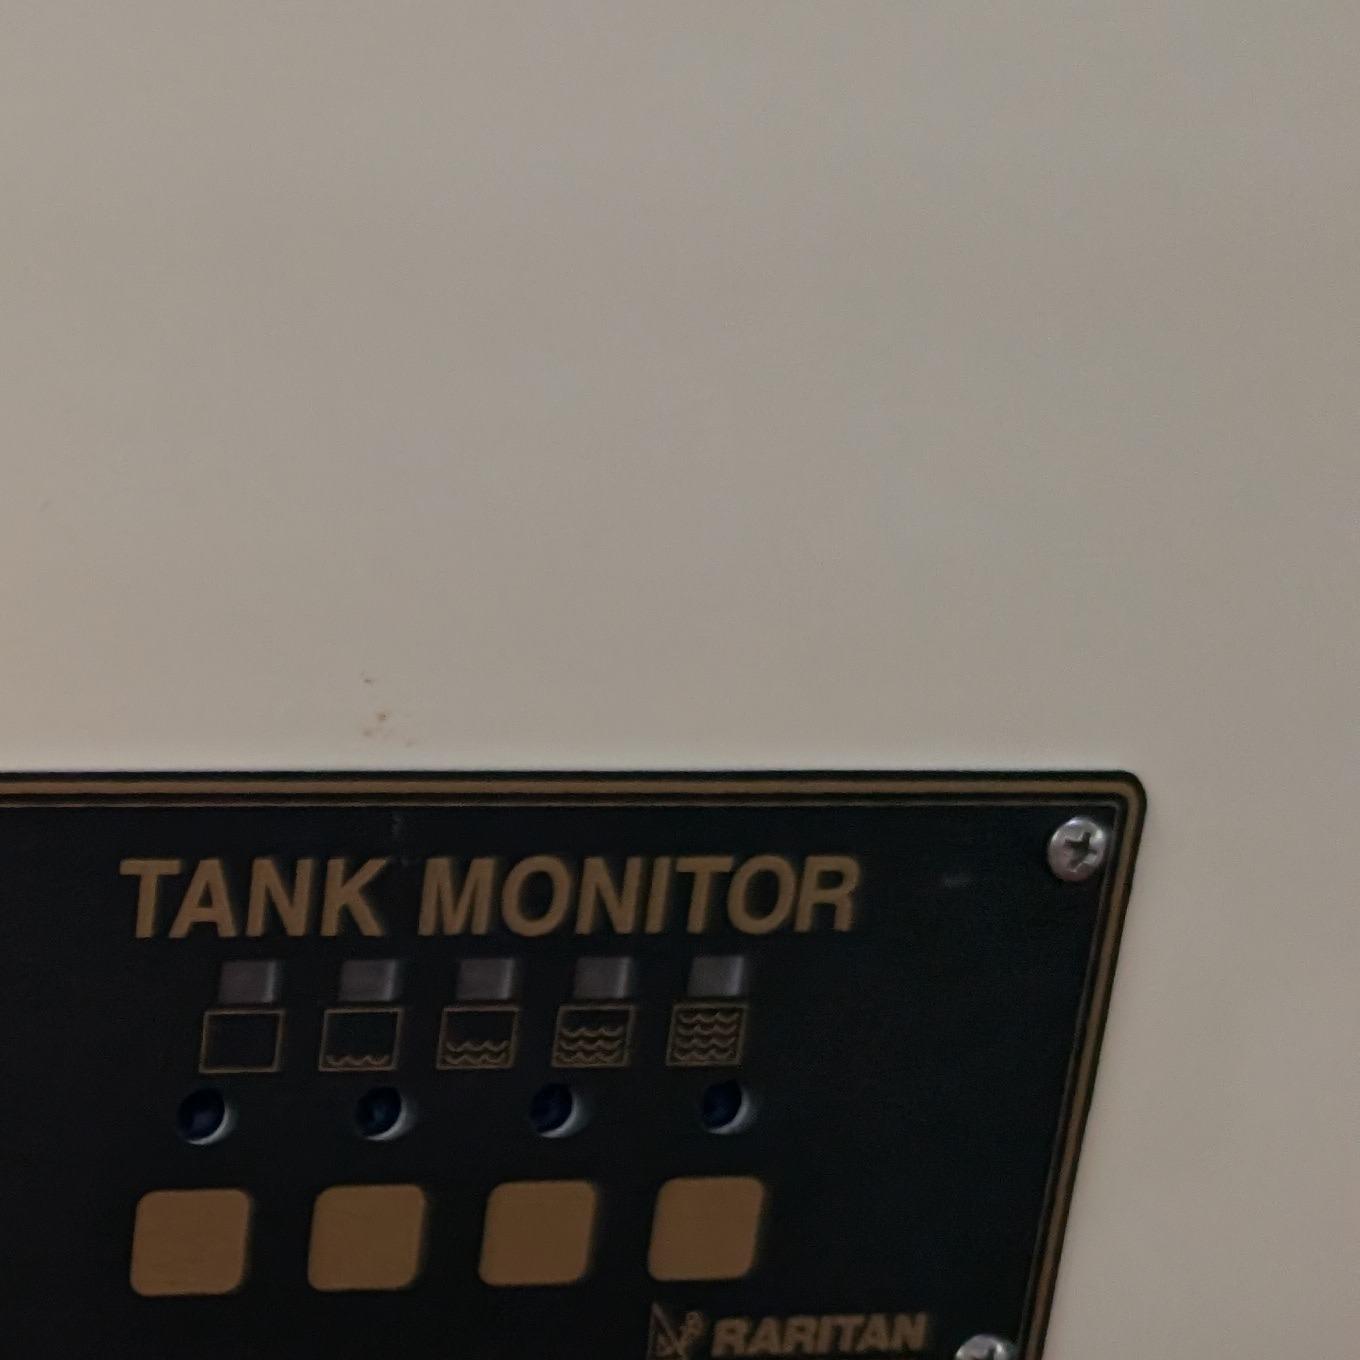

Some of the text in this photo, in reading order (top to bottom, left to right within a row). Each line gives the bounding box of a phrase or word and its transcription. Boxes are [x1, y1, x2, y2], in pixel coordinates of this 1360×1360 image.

[120, 855, 862, 938] TANK MONITOR
[711, 1313, 928, 1356] RARITAN
